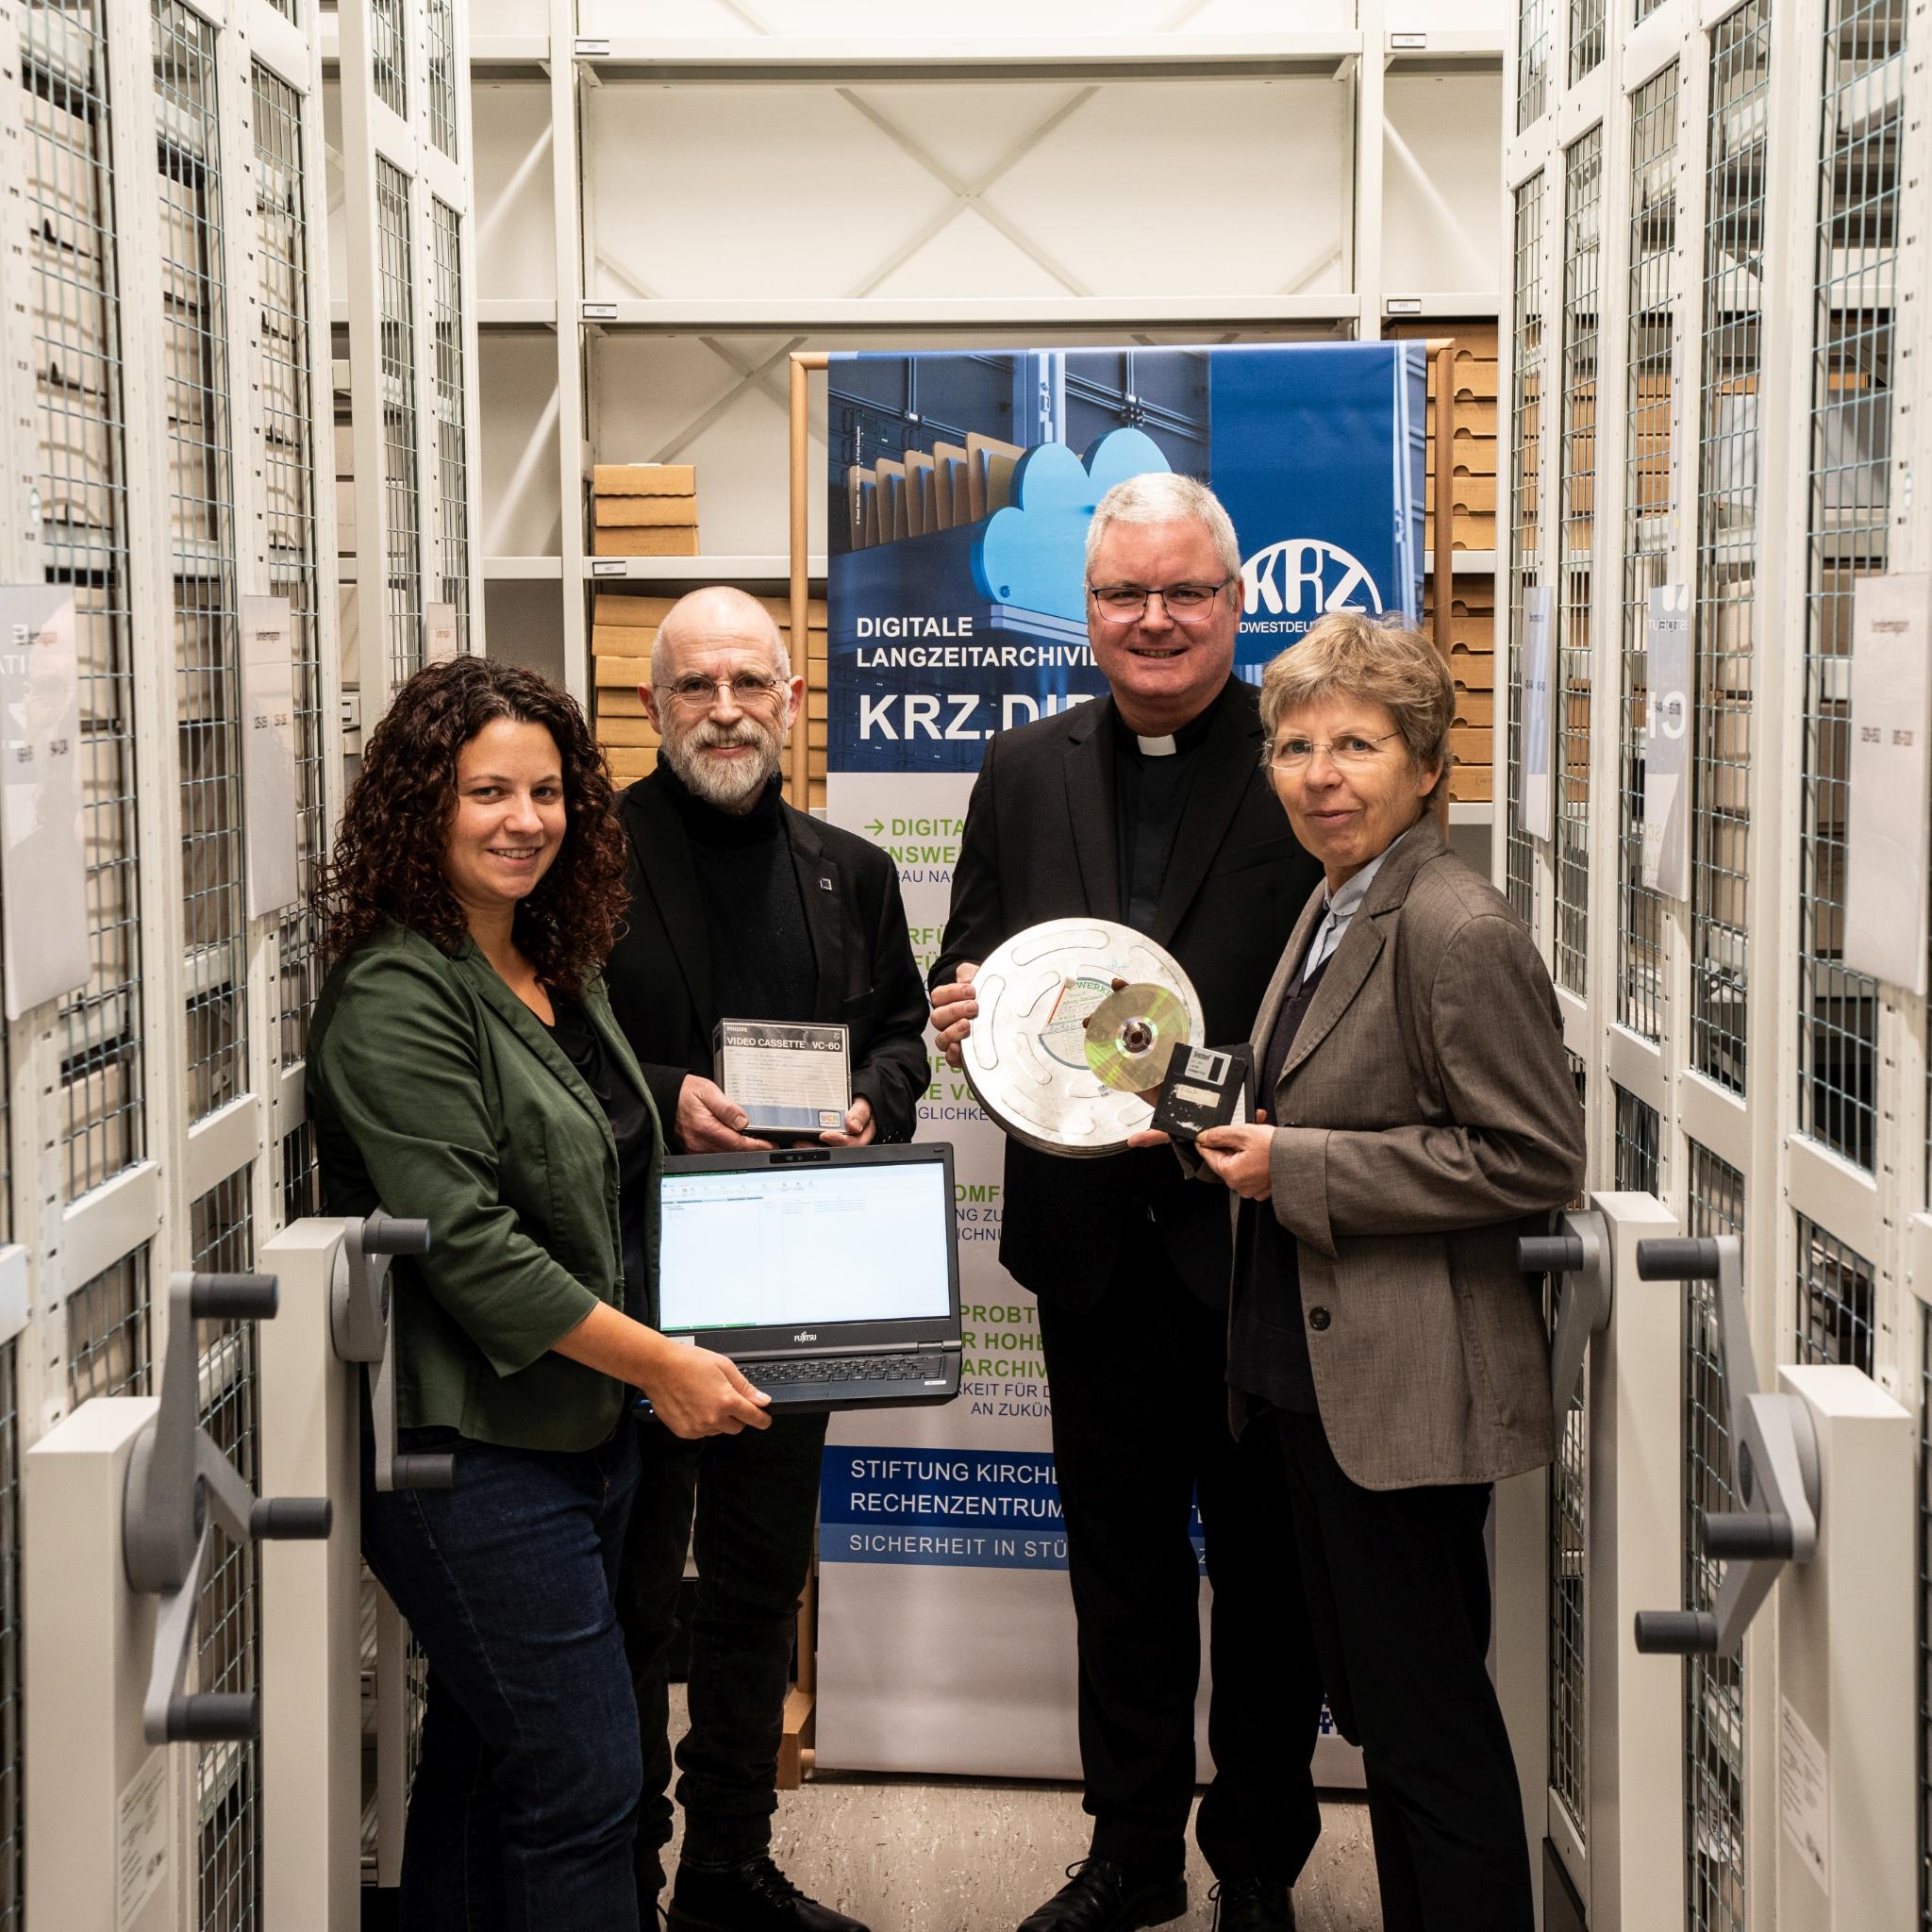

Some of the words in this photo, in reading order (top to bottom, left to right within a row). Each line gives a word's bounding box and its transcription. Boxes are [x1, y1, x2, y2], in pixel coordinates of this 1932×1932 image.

[1241, 539, 1367, 614] KRZ
[857, 617, 974, 638] DIGITALE
[859, 693, 1095, 740] KRZ.DI
[726, 1037, 756, 1046] VIDEO
[758, 1039, 806, 1048] CASSETTE
[812, 1041, 841, 1051] VC-60
[793, 1333, 817, 1343] FUJITSU
[1005, 1382, 1038, 1398] FÜR
[971, 1402, 993, 1415] AN
[851, 1459, 969, 1482] STIFTUNG
[850, 1491, 1064, 1518] RECHENZENTRUM
[849, 1534, 986, 1556] SICHERHEIT
[994, 1539, 1015, 1557] IN
[1024, 1539, 1067, 1558] STÜ
